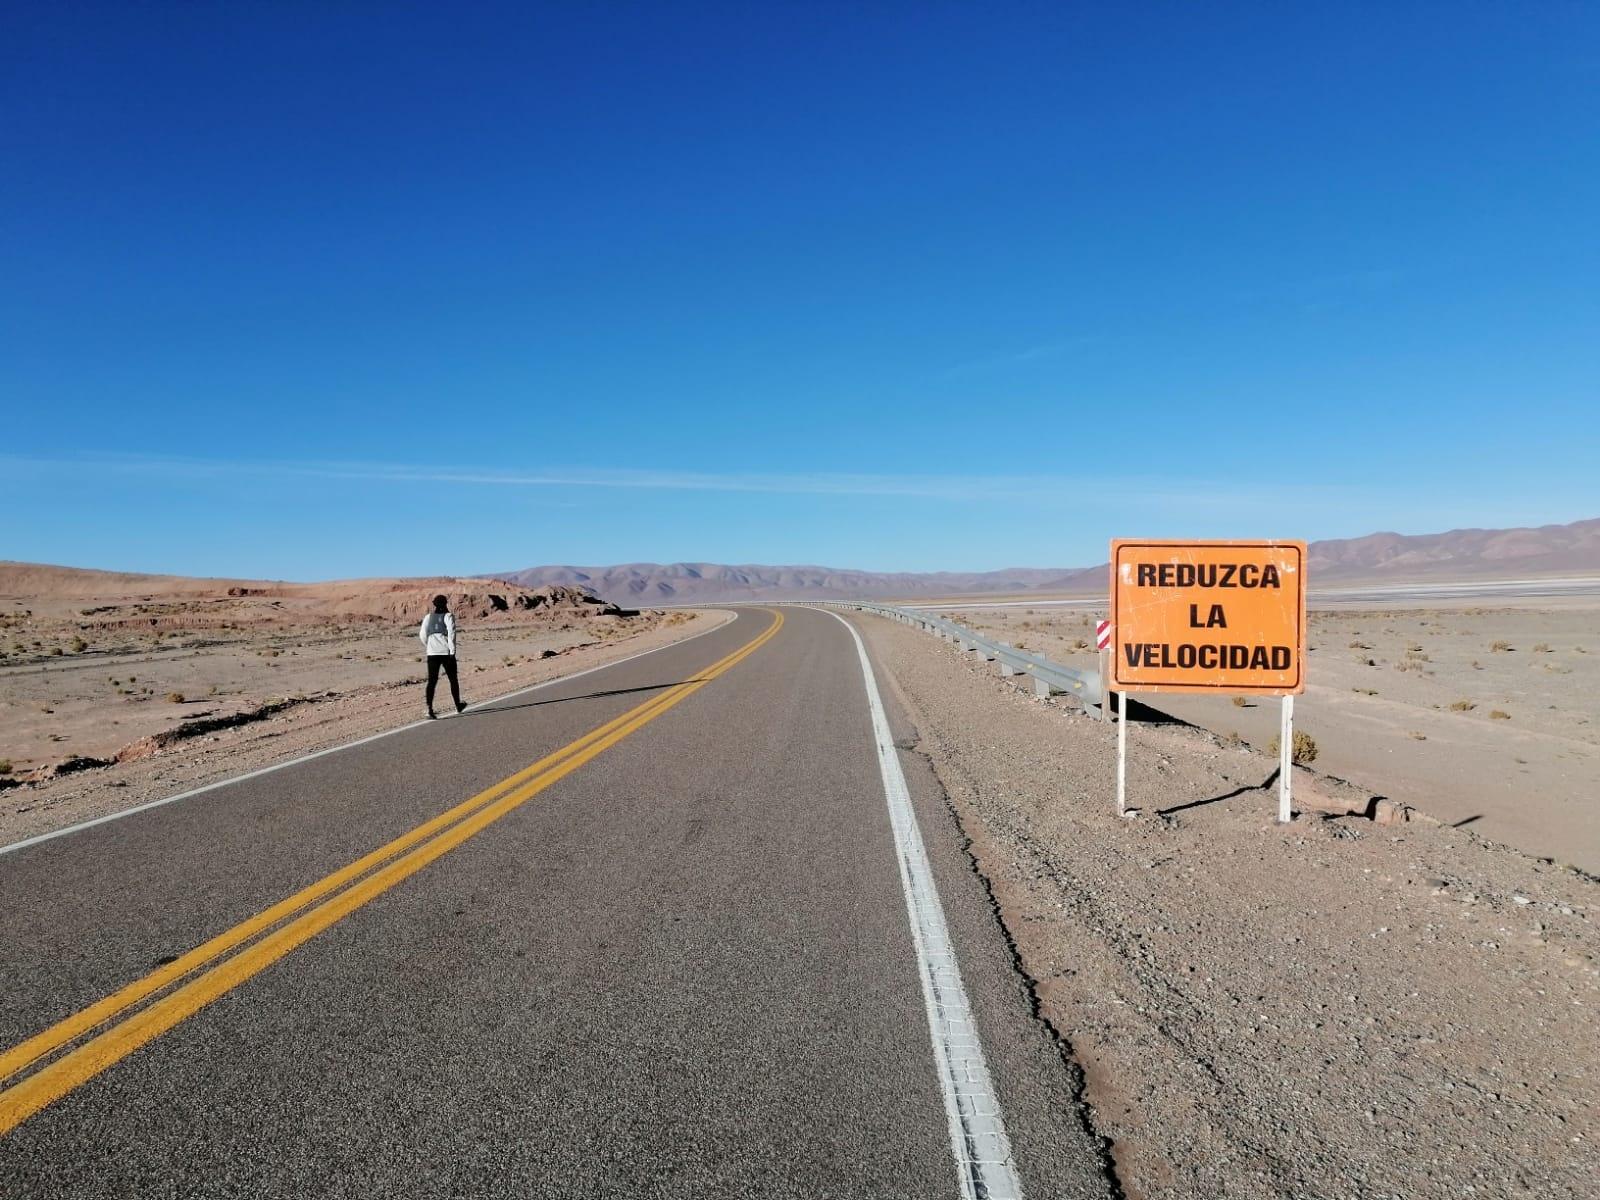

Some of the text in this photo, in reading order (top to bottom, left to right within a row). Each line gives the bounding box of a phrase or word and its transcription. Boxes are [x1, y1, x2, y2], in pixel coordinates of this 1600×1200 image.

[1137, 563, 1281, 588] REDUZCA
[1189, 604, 1227, 628] LA
[1124, 643, 1291, 671] VELOCIDAD
